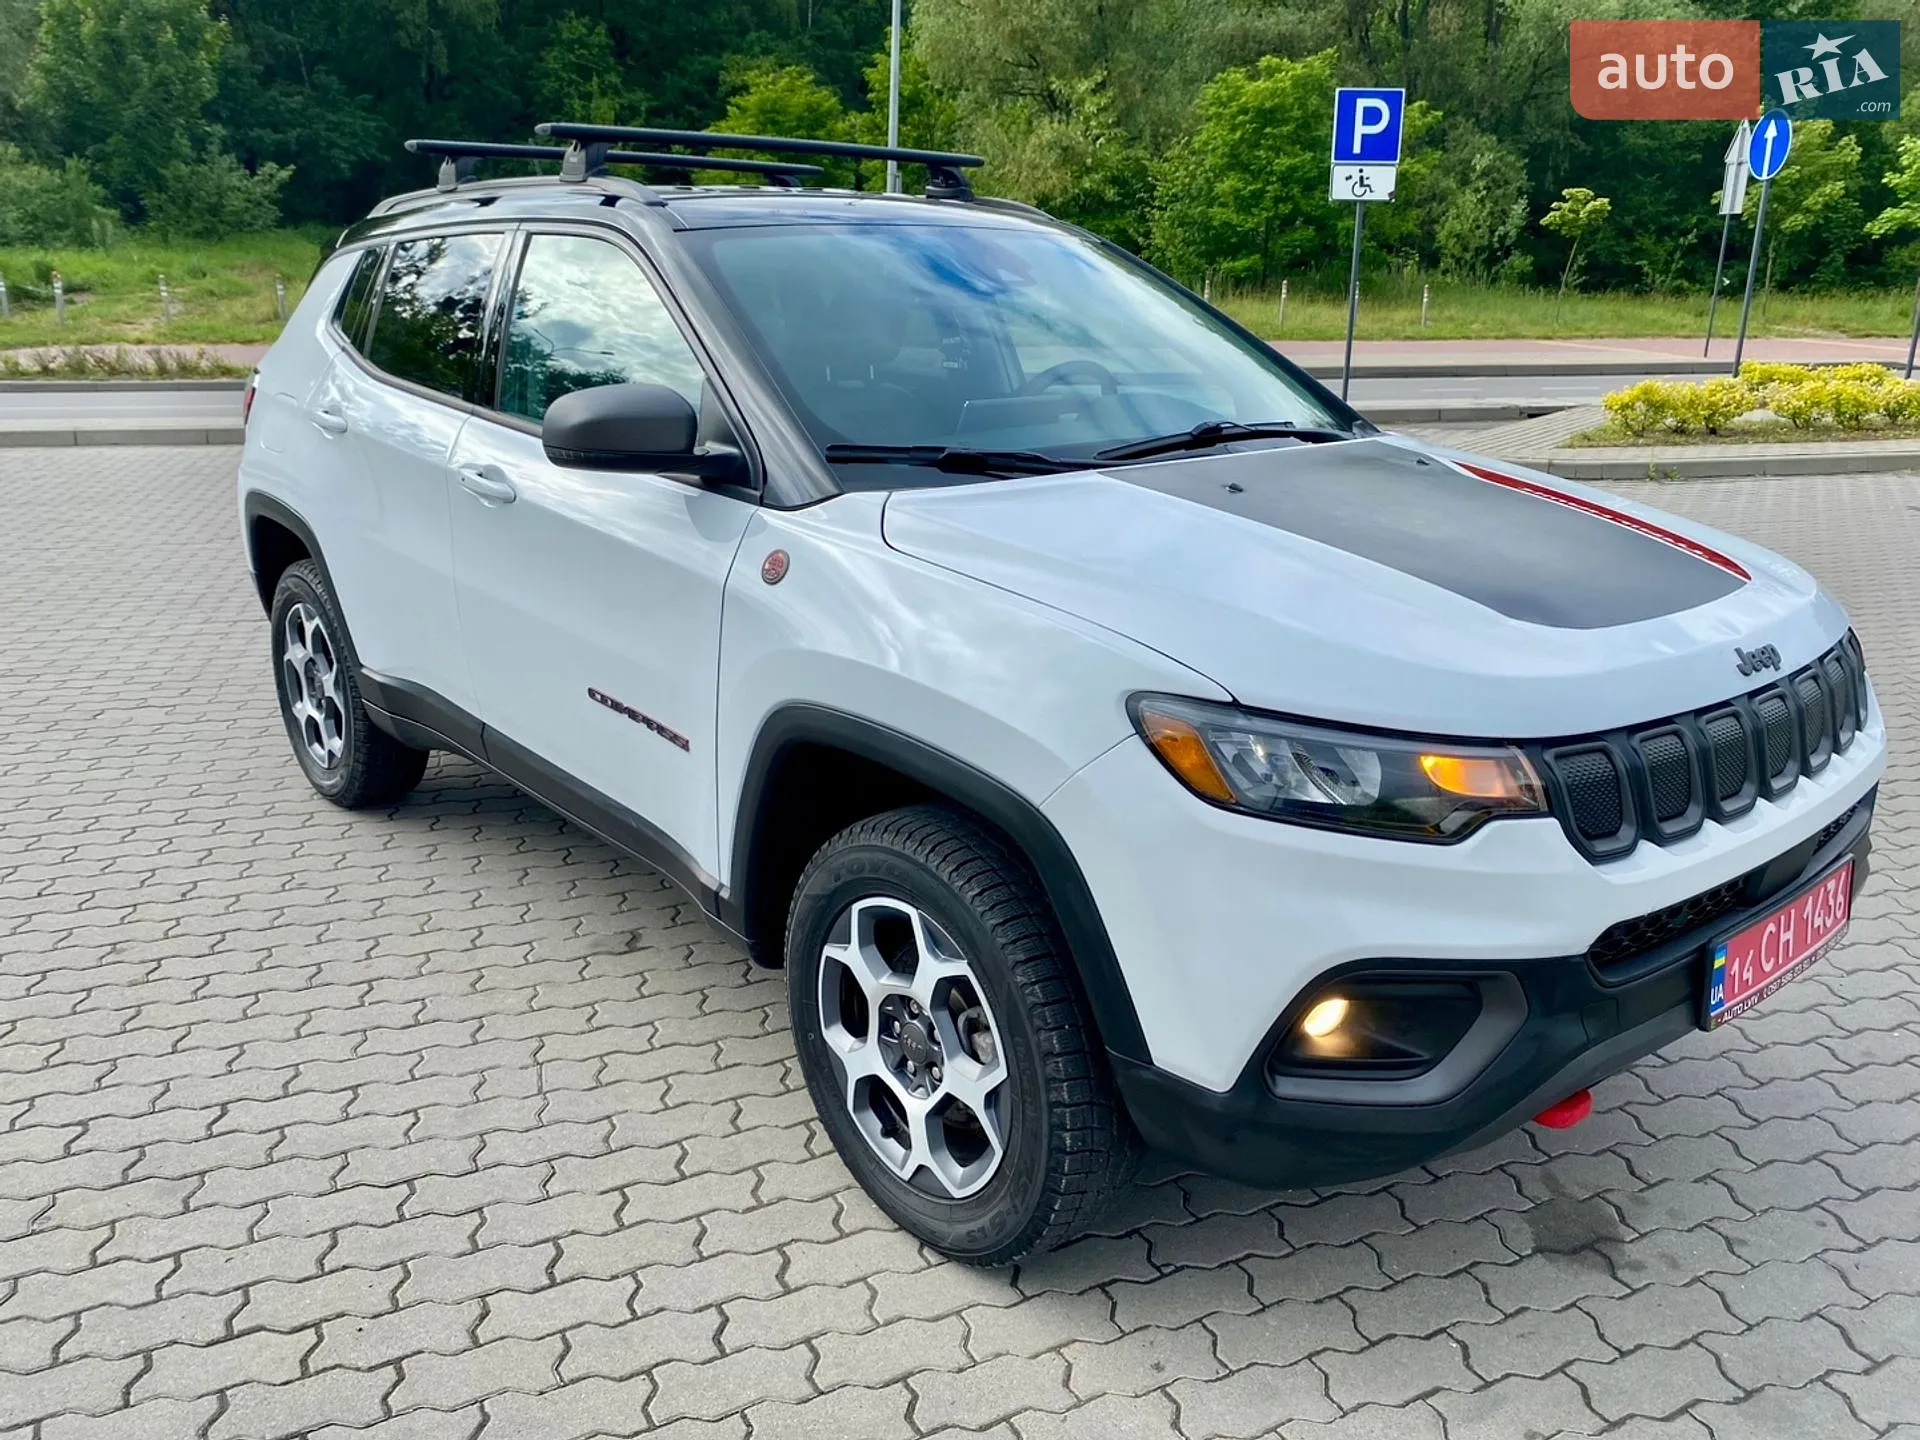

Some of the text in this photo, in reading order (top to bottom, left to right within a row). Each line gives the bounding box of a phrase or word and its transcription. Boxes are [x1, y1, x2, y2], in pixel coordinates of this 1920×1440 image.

[1352, 97, 1390, 155] P
[1733, 643, 1783, 677] Jeep
[1730, 949, 1754, 994] 14
[1761, 909, 1795, 972] CH
[1803, 871, 1847, 945] 1436
[1711, 984, 1724, 1005] UA
